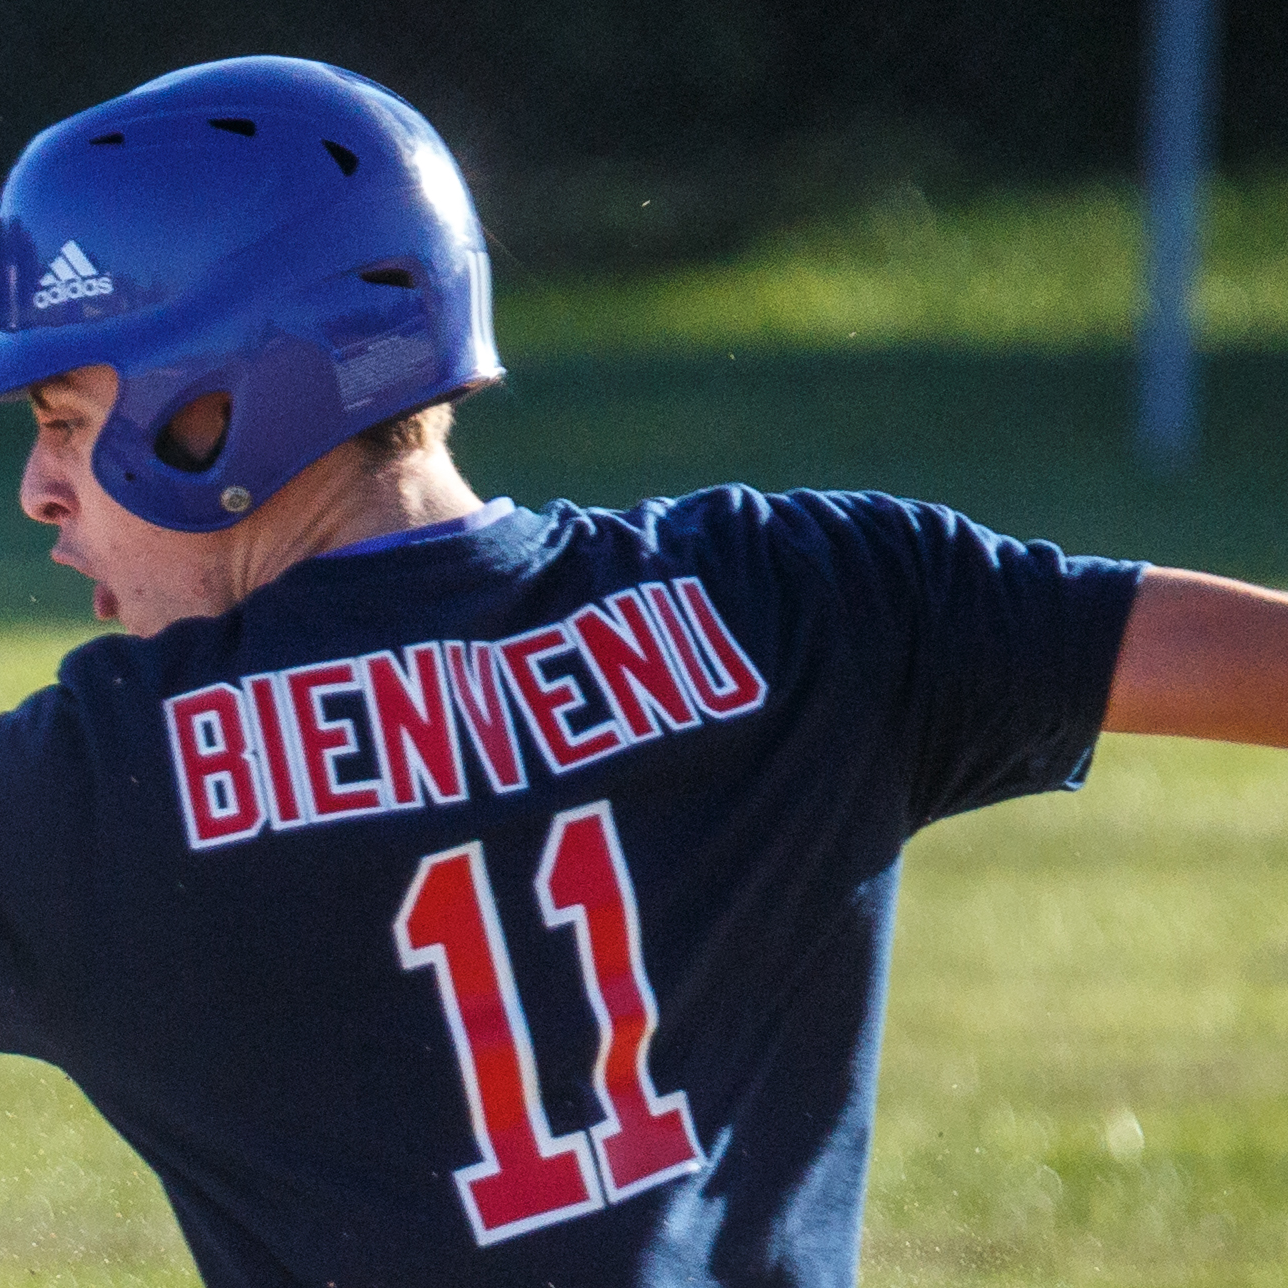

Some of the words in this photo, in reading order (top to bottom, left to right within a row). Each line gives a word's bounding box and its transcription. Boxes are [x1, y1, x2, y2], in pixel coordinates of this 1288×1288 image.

[33, 276, 115, 309] adidas
[163, 576, 769, 851] BIENVENU
[393, 799, 705, 1246] 11
